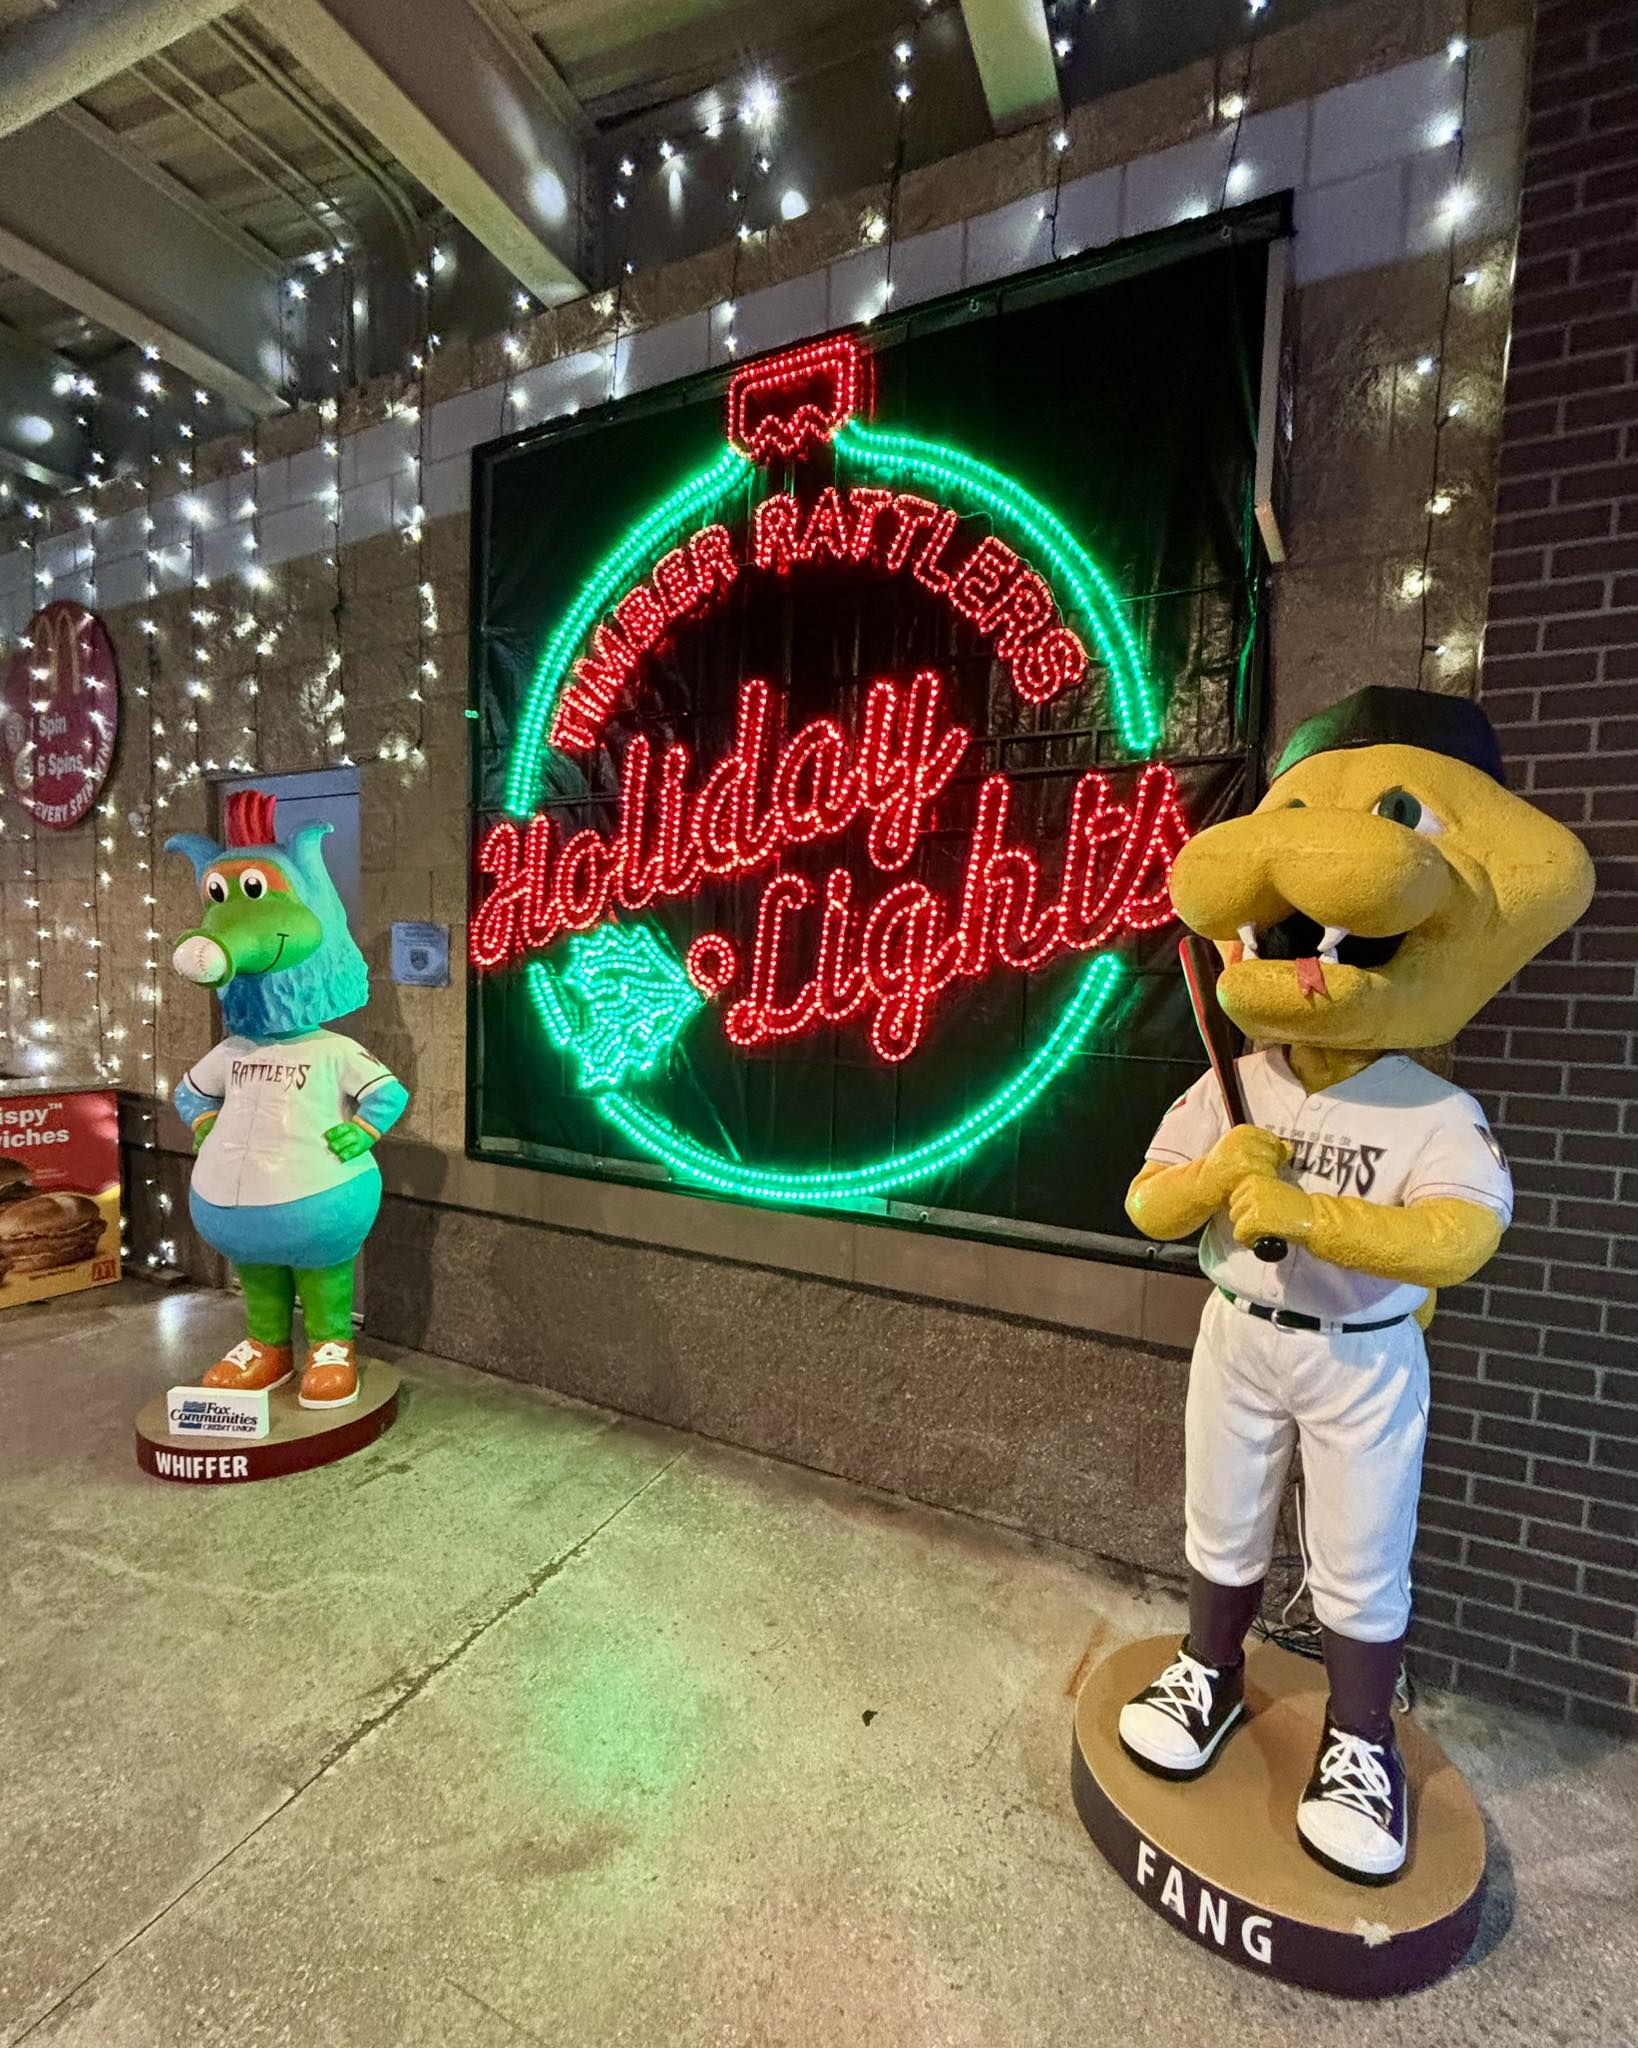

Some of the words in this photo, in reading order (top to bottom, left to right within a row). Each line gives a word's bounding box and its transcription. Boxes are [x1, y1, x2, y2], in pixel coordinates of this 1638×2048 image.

[547, 524, 739, 752] TIMBER
[754, 486, 1089, 703] RATTLERS
[470, 670, 970, 967] Holiday
[724, 763, 1191, 1062] Lights
[231, 1060, 311, 1094] RATTLERS
[0, 1128, 70, 1149] iches
[1279, 1136, 1388, 1198] TLERS
[170, 1408, 258, 1426] Communities
[206, 1402, 231, 1414] Fox
[203, 1424, 231, 1432] CREDIT
[232, 1425, 257, 1433] UNION
[155, 1451, 249, 1479] WHIFFER
[1136, 1840, 1273, 1965] FANG
